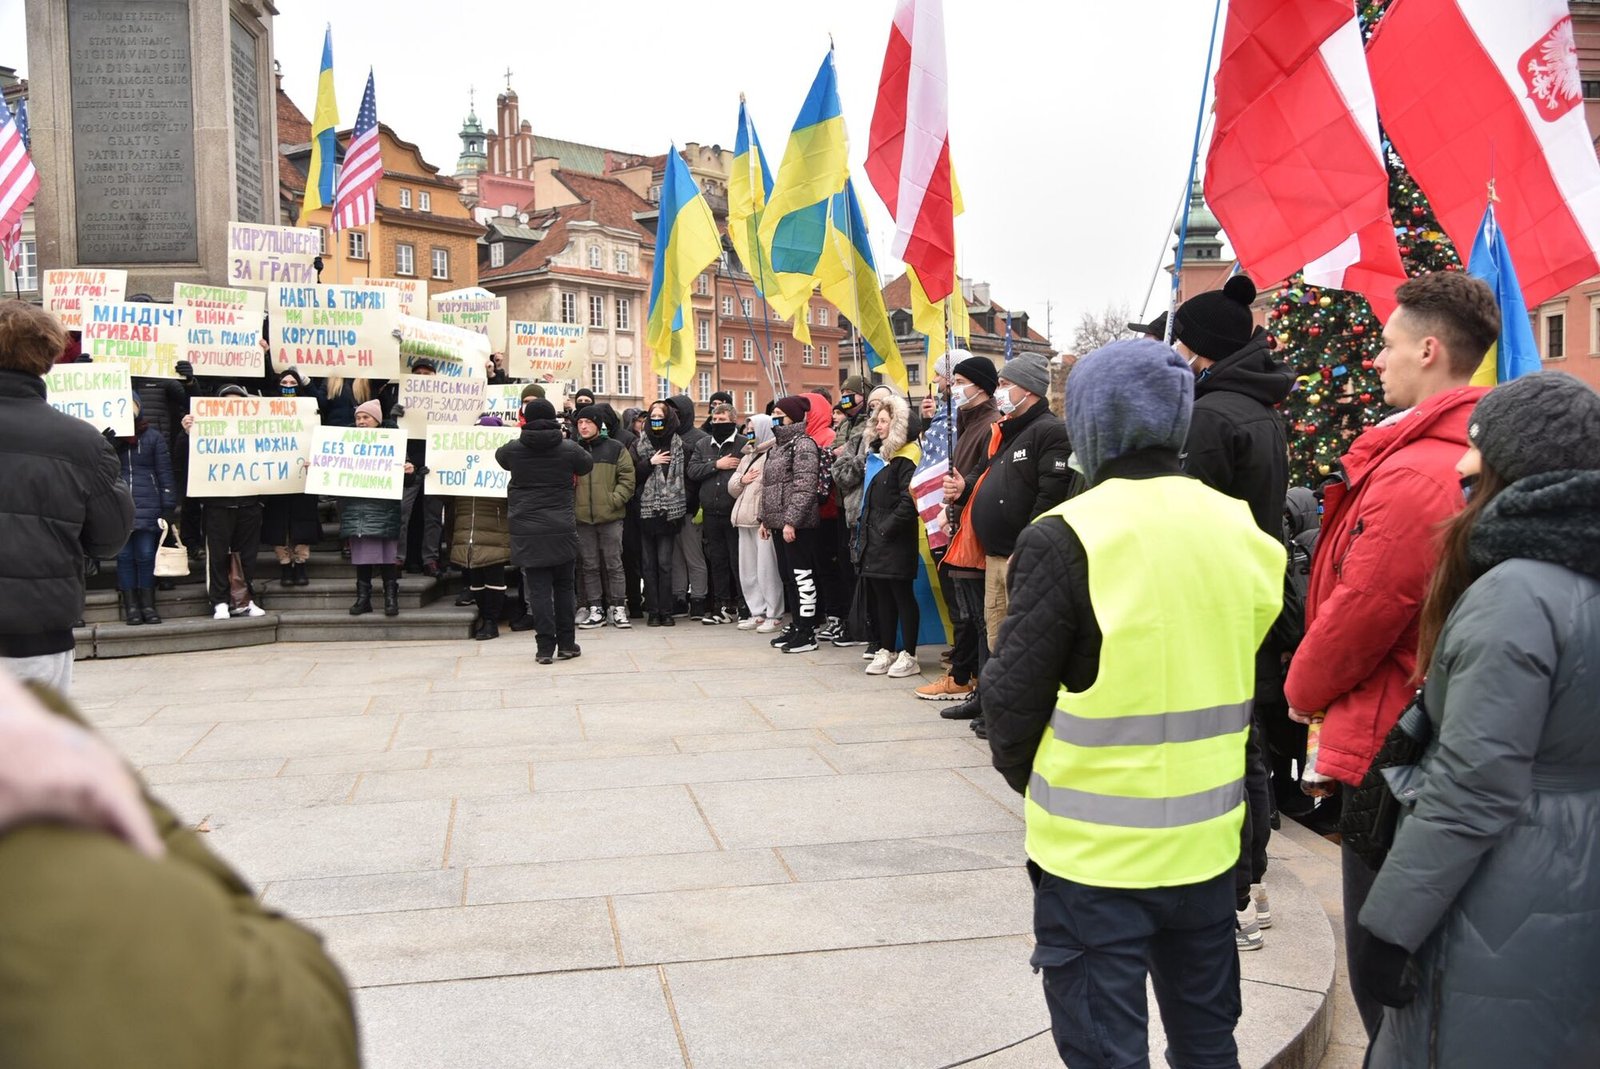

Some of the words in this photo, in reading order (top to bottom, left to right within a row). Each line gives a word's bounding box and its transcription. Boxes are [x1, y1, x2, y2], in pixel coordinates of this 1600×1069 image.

[88, 37, 137, 46] STATVAM
[141, 37, 172, 46] HANC
[75, 49, 169, 60] SIGISMVNDO
[75, 63, 171, 74] VLADISLAVS
[108, 88, 156, 99] FILIVS
[107, 136, 161, 146] GRATVS
[87, 150, 125, 160] PATRI
[127, 149, 182, 160] PATRIAE
[48, 271, 107, 285] КОРУПЦІЯ
[232, 258, 253, 280] ЗА
[259, 260, 314, 284] ГРАТИ
[54, 285, 69, 297] НА
[179, 284, 248, 304] КОРУПЦІЯ
[327, 288, 337, 310] В
[340, 289, 386, 310] ТЕМРЯВІ
[50, 298, 82, 312] ГІРШЕ
[93, 304, 183, 327] МІНДІЧ!
[312, 309, 364, 326] БАЧИМО
[441, 312, 456, 325] НА
[460, 311, 491, 325] ФРОНТ
[85, 323, 158, 343] КРИВАВІ
[188, 328, 215, 345] АТЬ
[281, 326, 357, 349] КОРУПЦІЮ
[514, 321, 537, 336] ГОДІ
[541, 324, 585, 340] МОВЧАТИ!
[92, 338, 148, 358] ГРОШІ
[516, 335, 566, 348] КОРУПЦІЯ
[187, 349, 263, 369] ОРУПЦІОНЕРІВ
[278, 347, 289, 364] А
[195, 398, 260, 418] СПОЧАТКУ
[194, 419, 229, 437] ТЕПЕР
[237, 418, 305, 435] ЕНЕРГЕТИКА
[196, 437, 246, 455] СКІЛЬКИ
[254, 435, 299, 453] МОЖНА
[321, 440, 345, 455] БЕЗ
[352, 443, 397, 457] СВІТЛА
[465, 454, 481, 470] де
[207, 460, 290, 482] КРАСТИ
[435, 467, 467, 487] ТВОЇ
[473, 470, 509, 490] ДРУЗІ
[793, 568, 818, 618] DKNY
